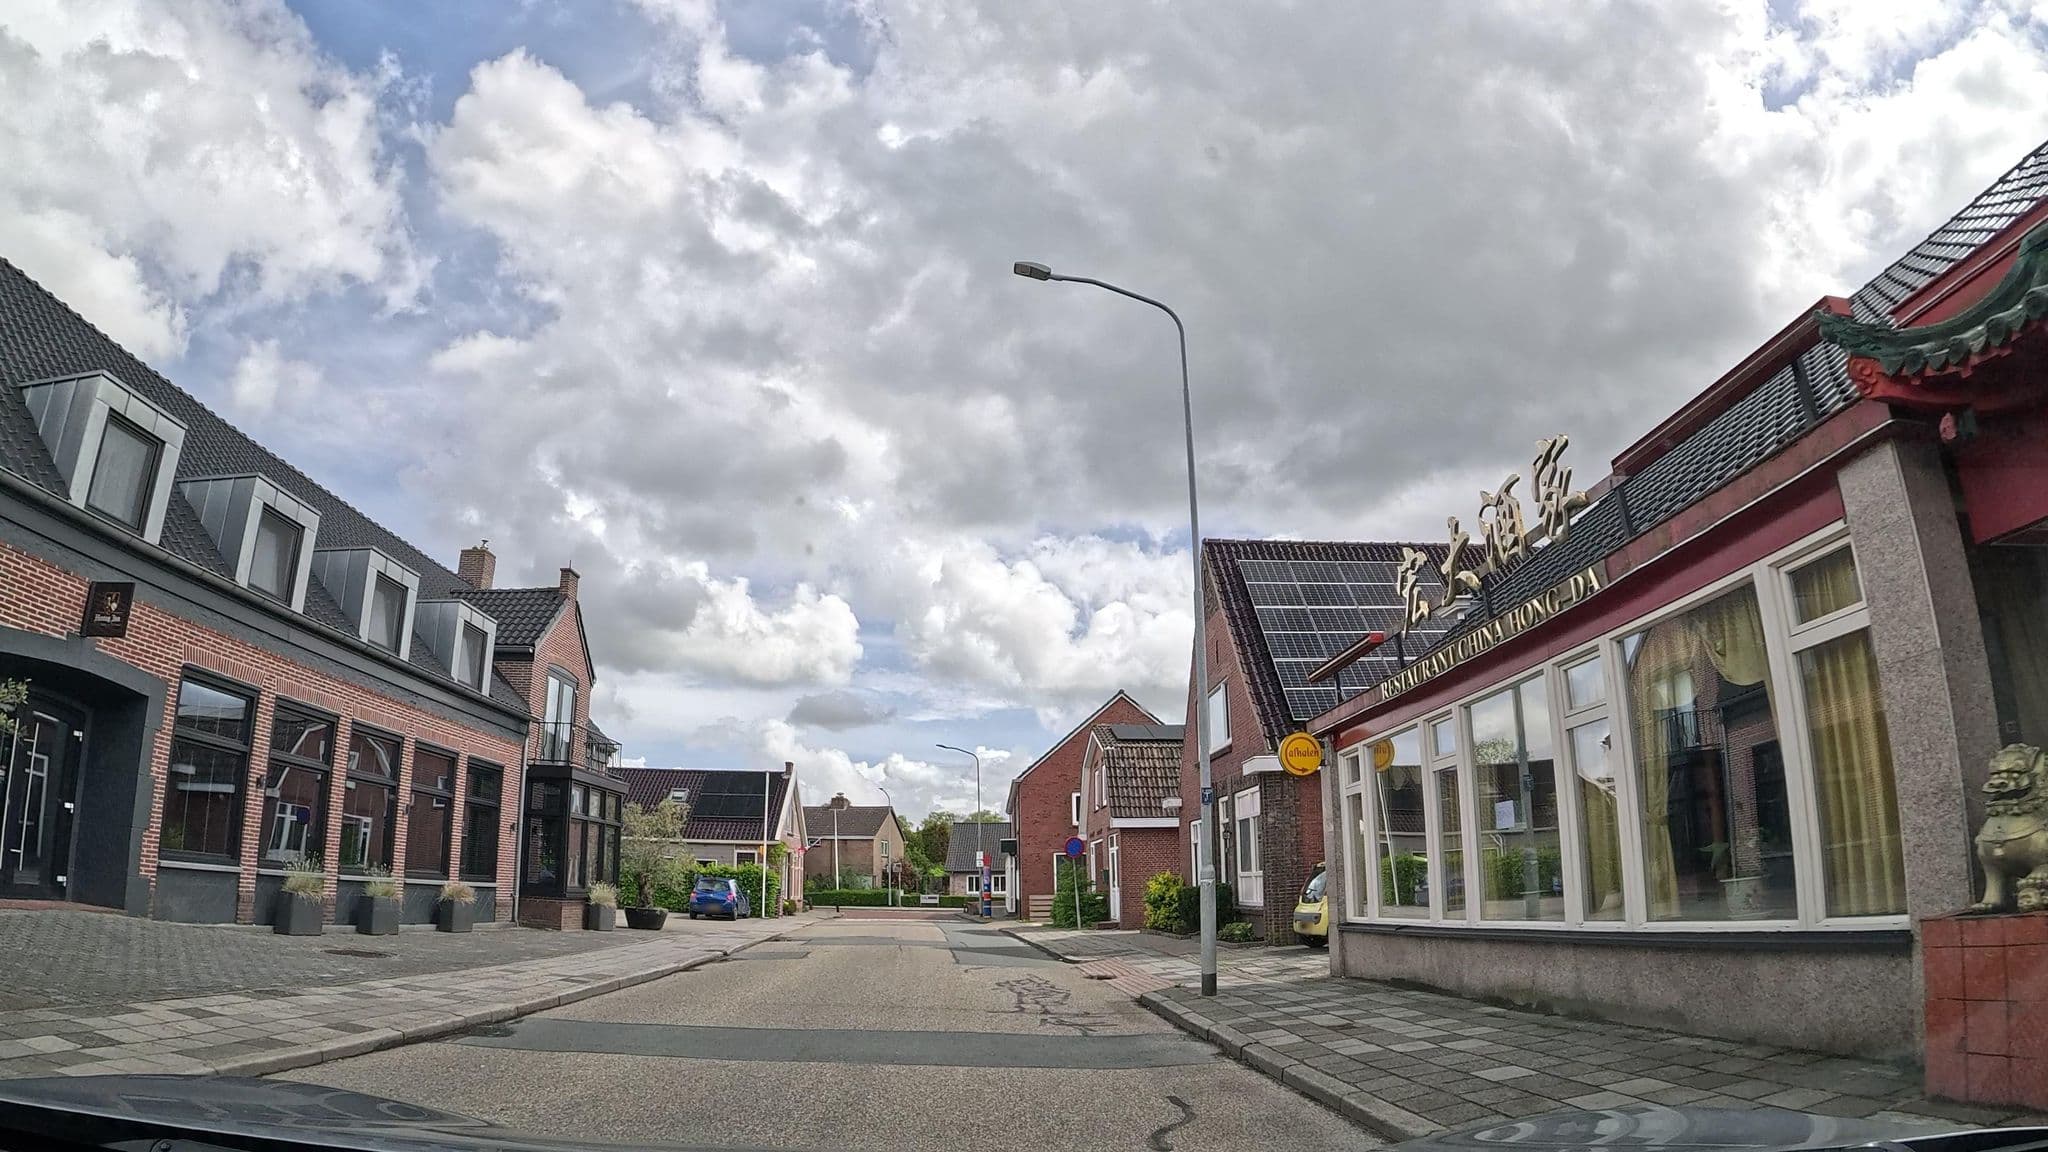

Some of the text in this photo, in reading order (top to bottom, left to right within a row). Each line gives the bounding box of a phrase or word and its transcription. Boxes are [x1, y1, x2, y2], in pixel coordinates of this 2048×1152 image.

[1381, 643, 1457, 700] RESTAURANT
[1458, 619, 1506, 660] CHINA
[1289, 746, 1319, 757] afhalen
